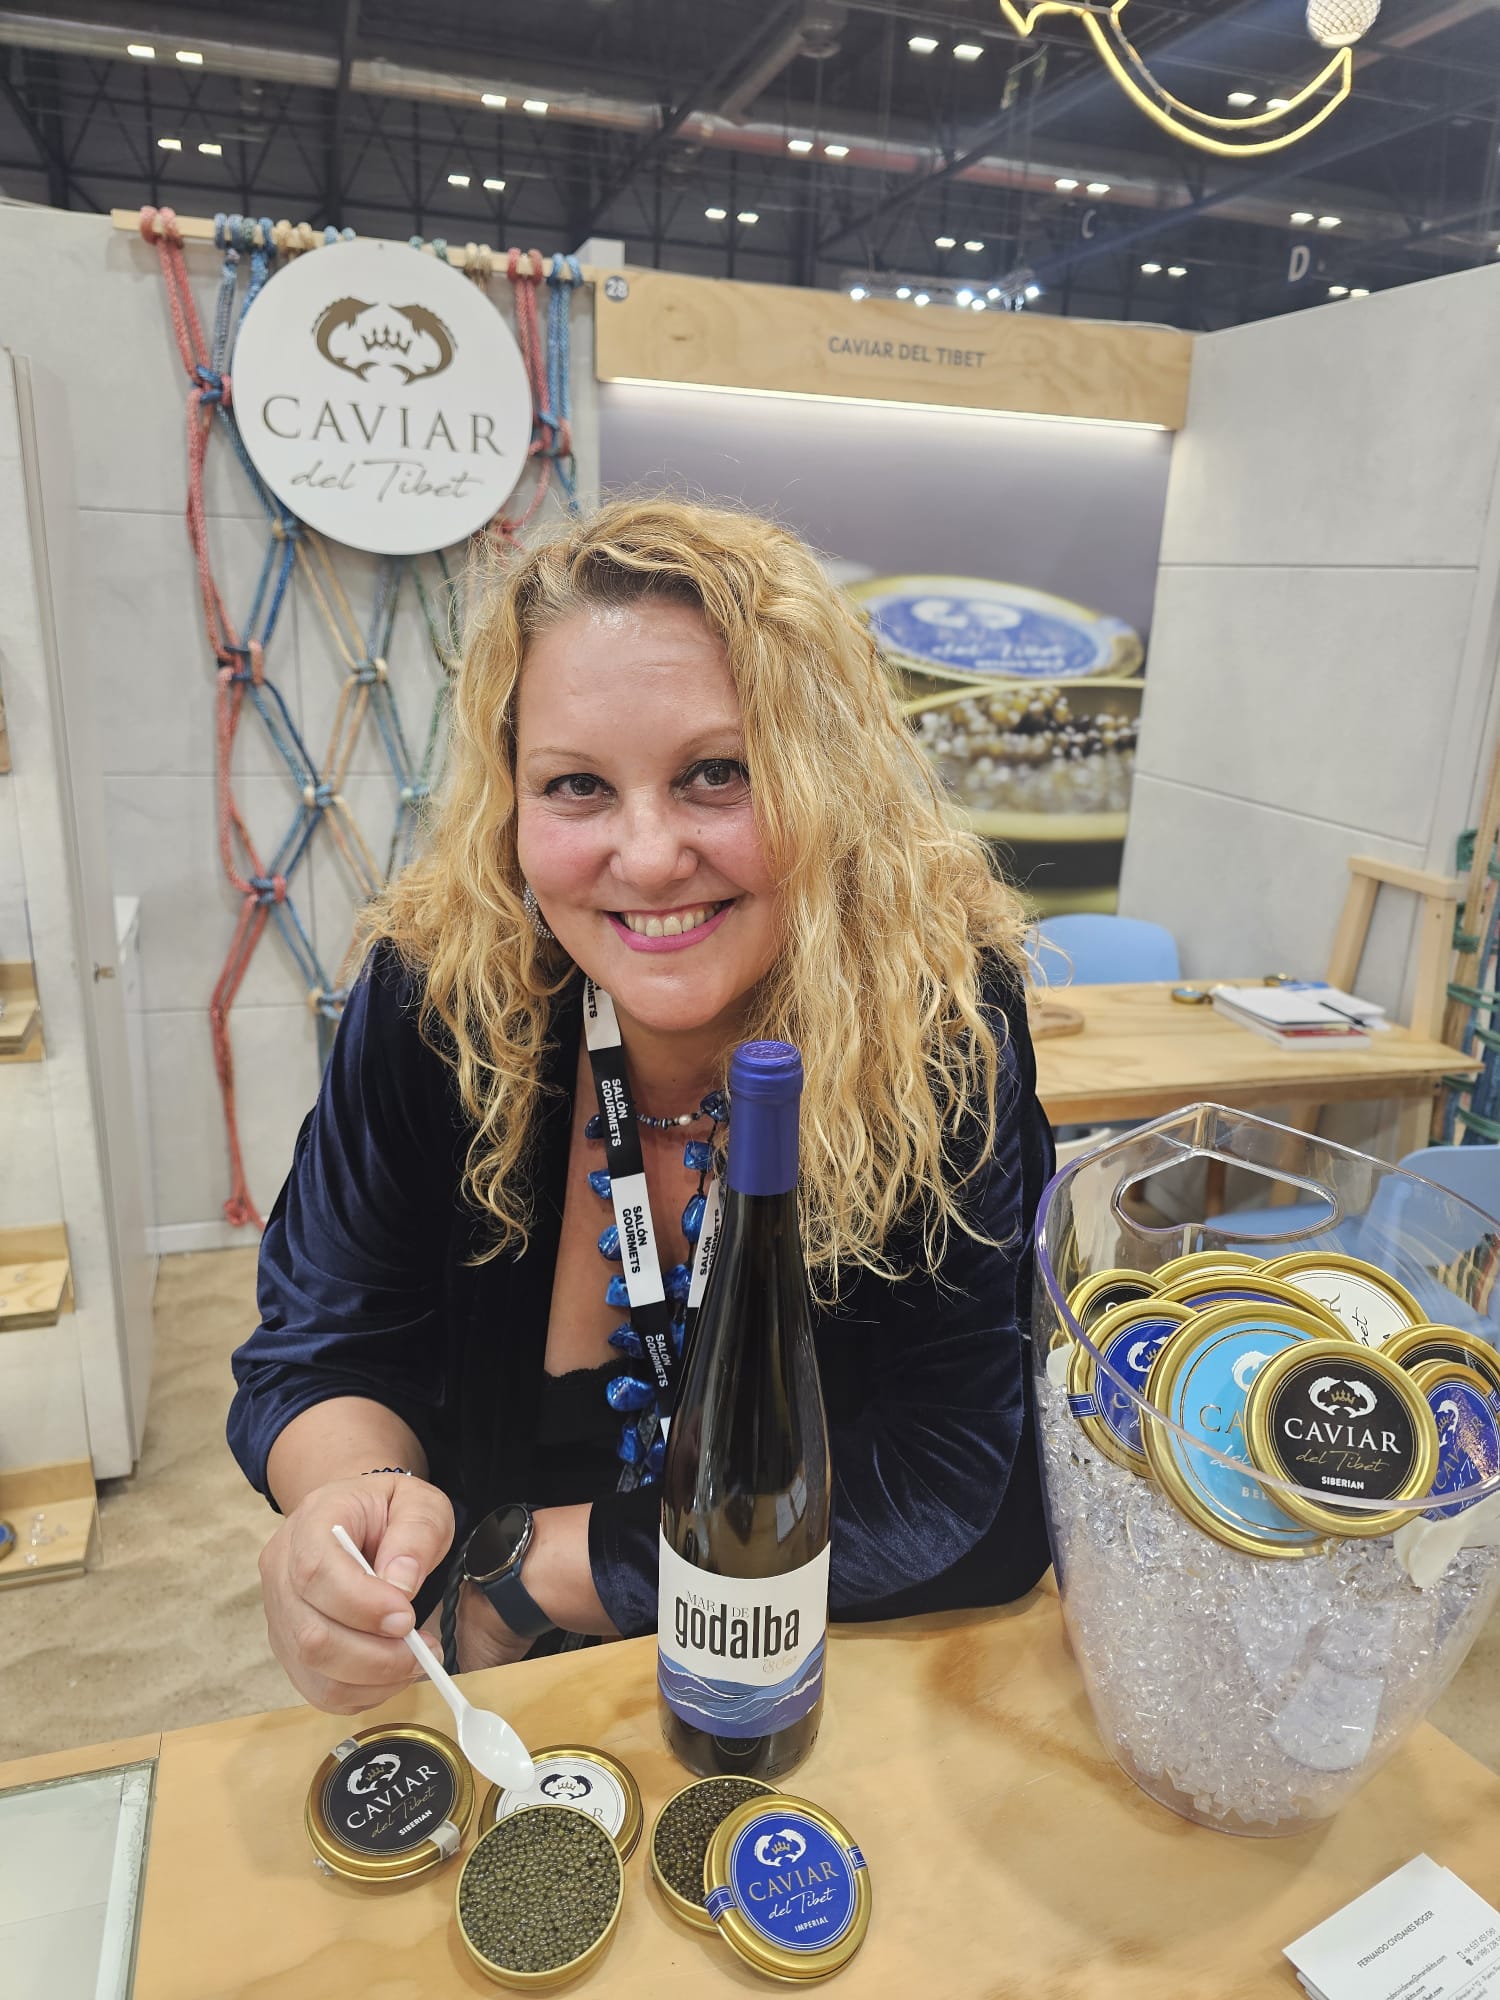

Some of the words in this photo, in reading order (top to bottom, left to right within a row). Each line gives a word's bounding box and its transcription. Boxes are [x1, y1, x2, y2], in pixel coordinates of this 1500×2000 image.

[1287, 245, 1311, 282] D
[607, 279, 627, 298] 28
[828, 336, 894, 359] CAVIAR
[898, 344, 932, 363] DEL
[936, 347, 987, 368] TIBET
[262, 395, 504, 457] CAVIAR
[290, 459, 356, 491] del
[363, 458, 484, 502] Tibet
[587, 976, 598, 1018] RMETS
[601, 1080, 622, 1147] GOURMETS
[611, 1078, 628, 1119] SALÓN
[622, 1208, 641, 1274] GOURMETS
[633, 1205, 649, 1246] SALÓN
[700, 1236, 712, 1276] SALÓN
[645, 1335, 669, 1388] GOURMETS
[655, 1333, 672, 1366] SALÓN
[1284, 1417, 1402, 1454] CAVIAR
[1295, 1448, 1328, 1465] del
[1328, 1450, 1390, 1472] Tibet
[1321, 1475, 1365, 1490] SIBERIAN
[686, 1591, 717, 1613] MAR
[731, 1607, 750, 1618] DE
[675, 1596, 800, 1659] godalba
[347, 1765, 440, 1829] CAVIAR
[371, 1813, 396, 1838] del
[391, 1784, 438, 1819] Tibet
[398, 1809, 433, 1836] SIBERIAN
[748, 1861, 840, 1901] CAVIAR
[768, 1900, 792, 1920] del
[790, 1887, 837, 1914] Tibet
[794, 1916, 829, 1933] IMPERIAL
[1356, 1943, 1389, 1968] FERNANDO
[1387, 1923, 1417, 1947] CIVIDANES
[1413, 1910, 1435, 1927] ROGER
